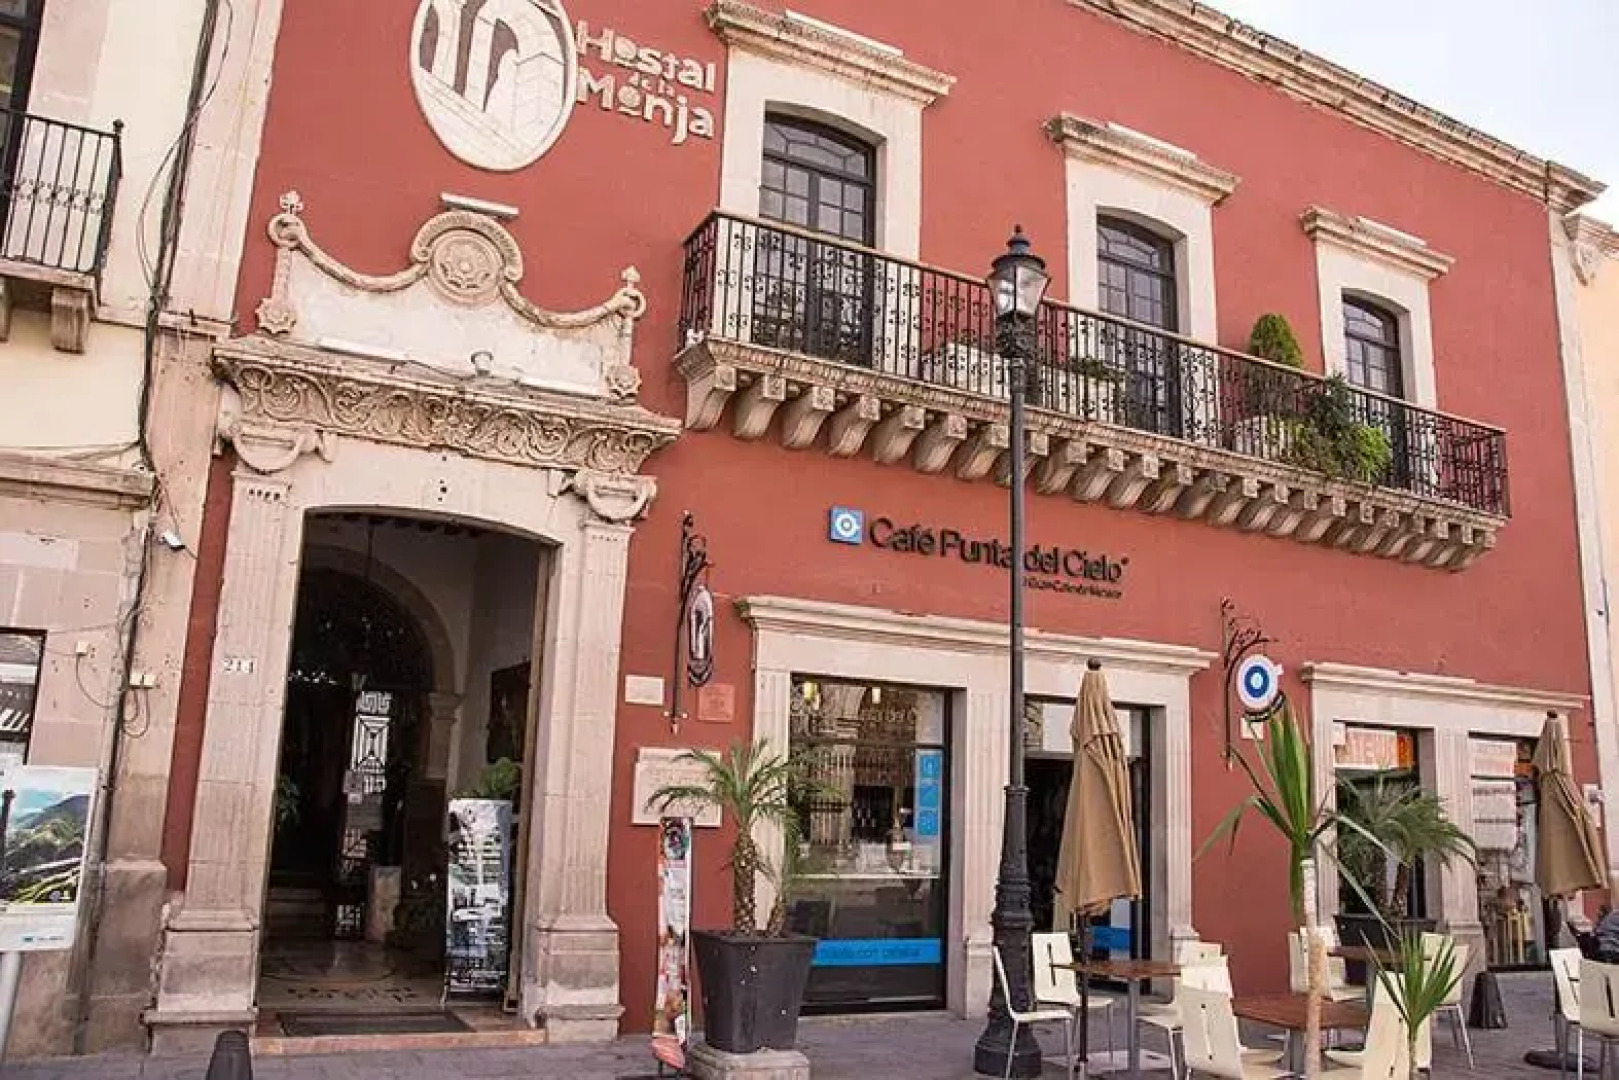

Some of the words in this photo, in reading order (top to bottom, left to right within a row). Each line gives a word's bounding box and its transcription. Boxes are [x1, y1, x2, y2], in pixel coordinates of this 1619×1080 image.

[576, 20, 716, 93] Hostal
[576, 66, 714, 146] Monja
[869, 517, 935, 555] Café
[940, 529, 1013, 569] Punta
[1024, 543, 1058, 575] del
[1063, 549, 1122, 582] Cielo
